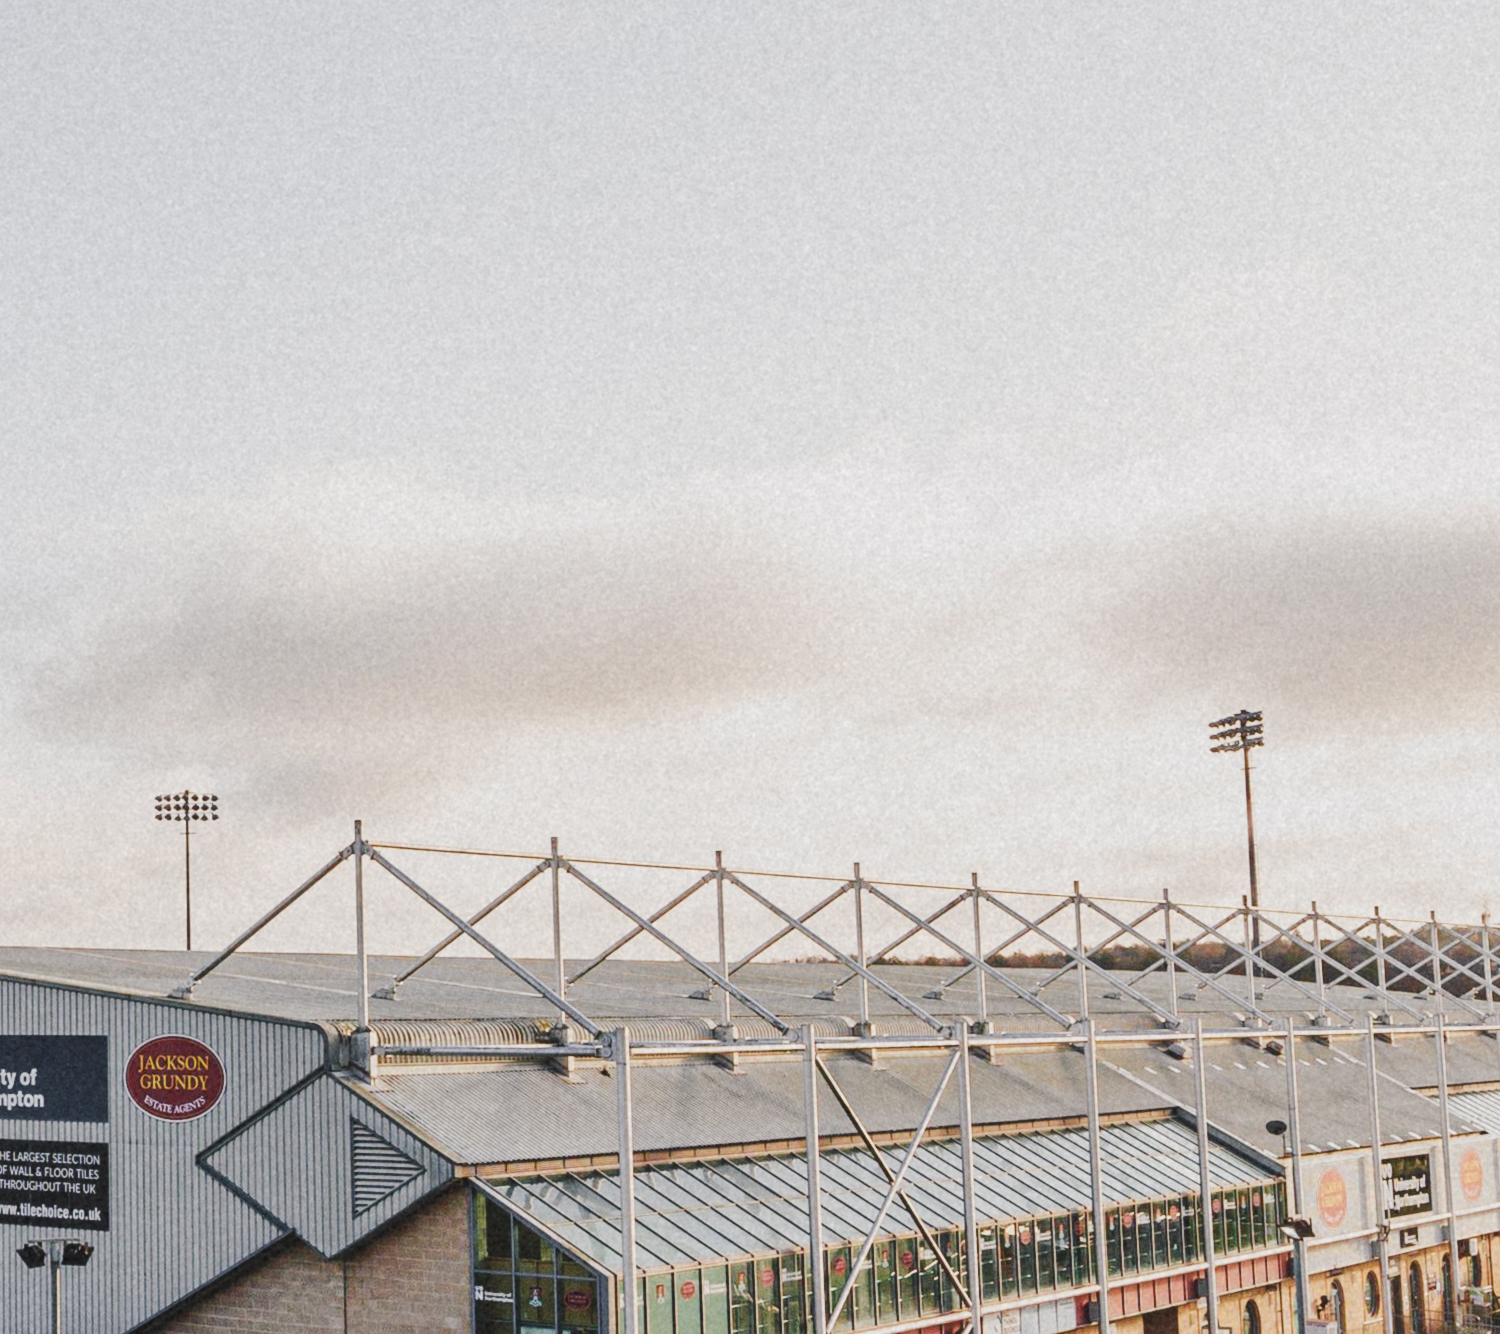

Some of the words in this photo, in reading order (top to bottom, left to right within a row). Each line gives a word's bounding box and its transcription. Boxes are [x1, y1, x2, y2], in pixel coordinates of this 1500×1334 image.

[138, 1054, 209, 1073] JACKSON
[19, 1068, 37, 1086] of
[140, 1074, 209, 1091] GRUNDY
[144, 1095, 173, 1113] ESTATE
[173, 1095, 206, 1114] AGENTS
[13, 1152, 50, 1163] LARGEST
[52, 1153, 100, 1165] SELECTION
[9, 1166, 34, 1177] WALL
[35, 1167, 42, 1177] &
[44, 1167, 74, 1179] FLOOR
[75, 1169, 99, 1180] TILES
[63, 1182, 81, 1193] THE
[82, 1183, 96, 1194] UK
